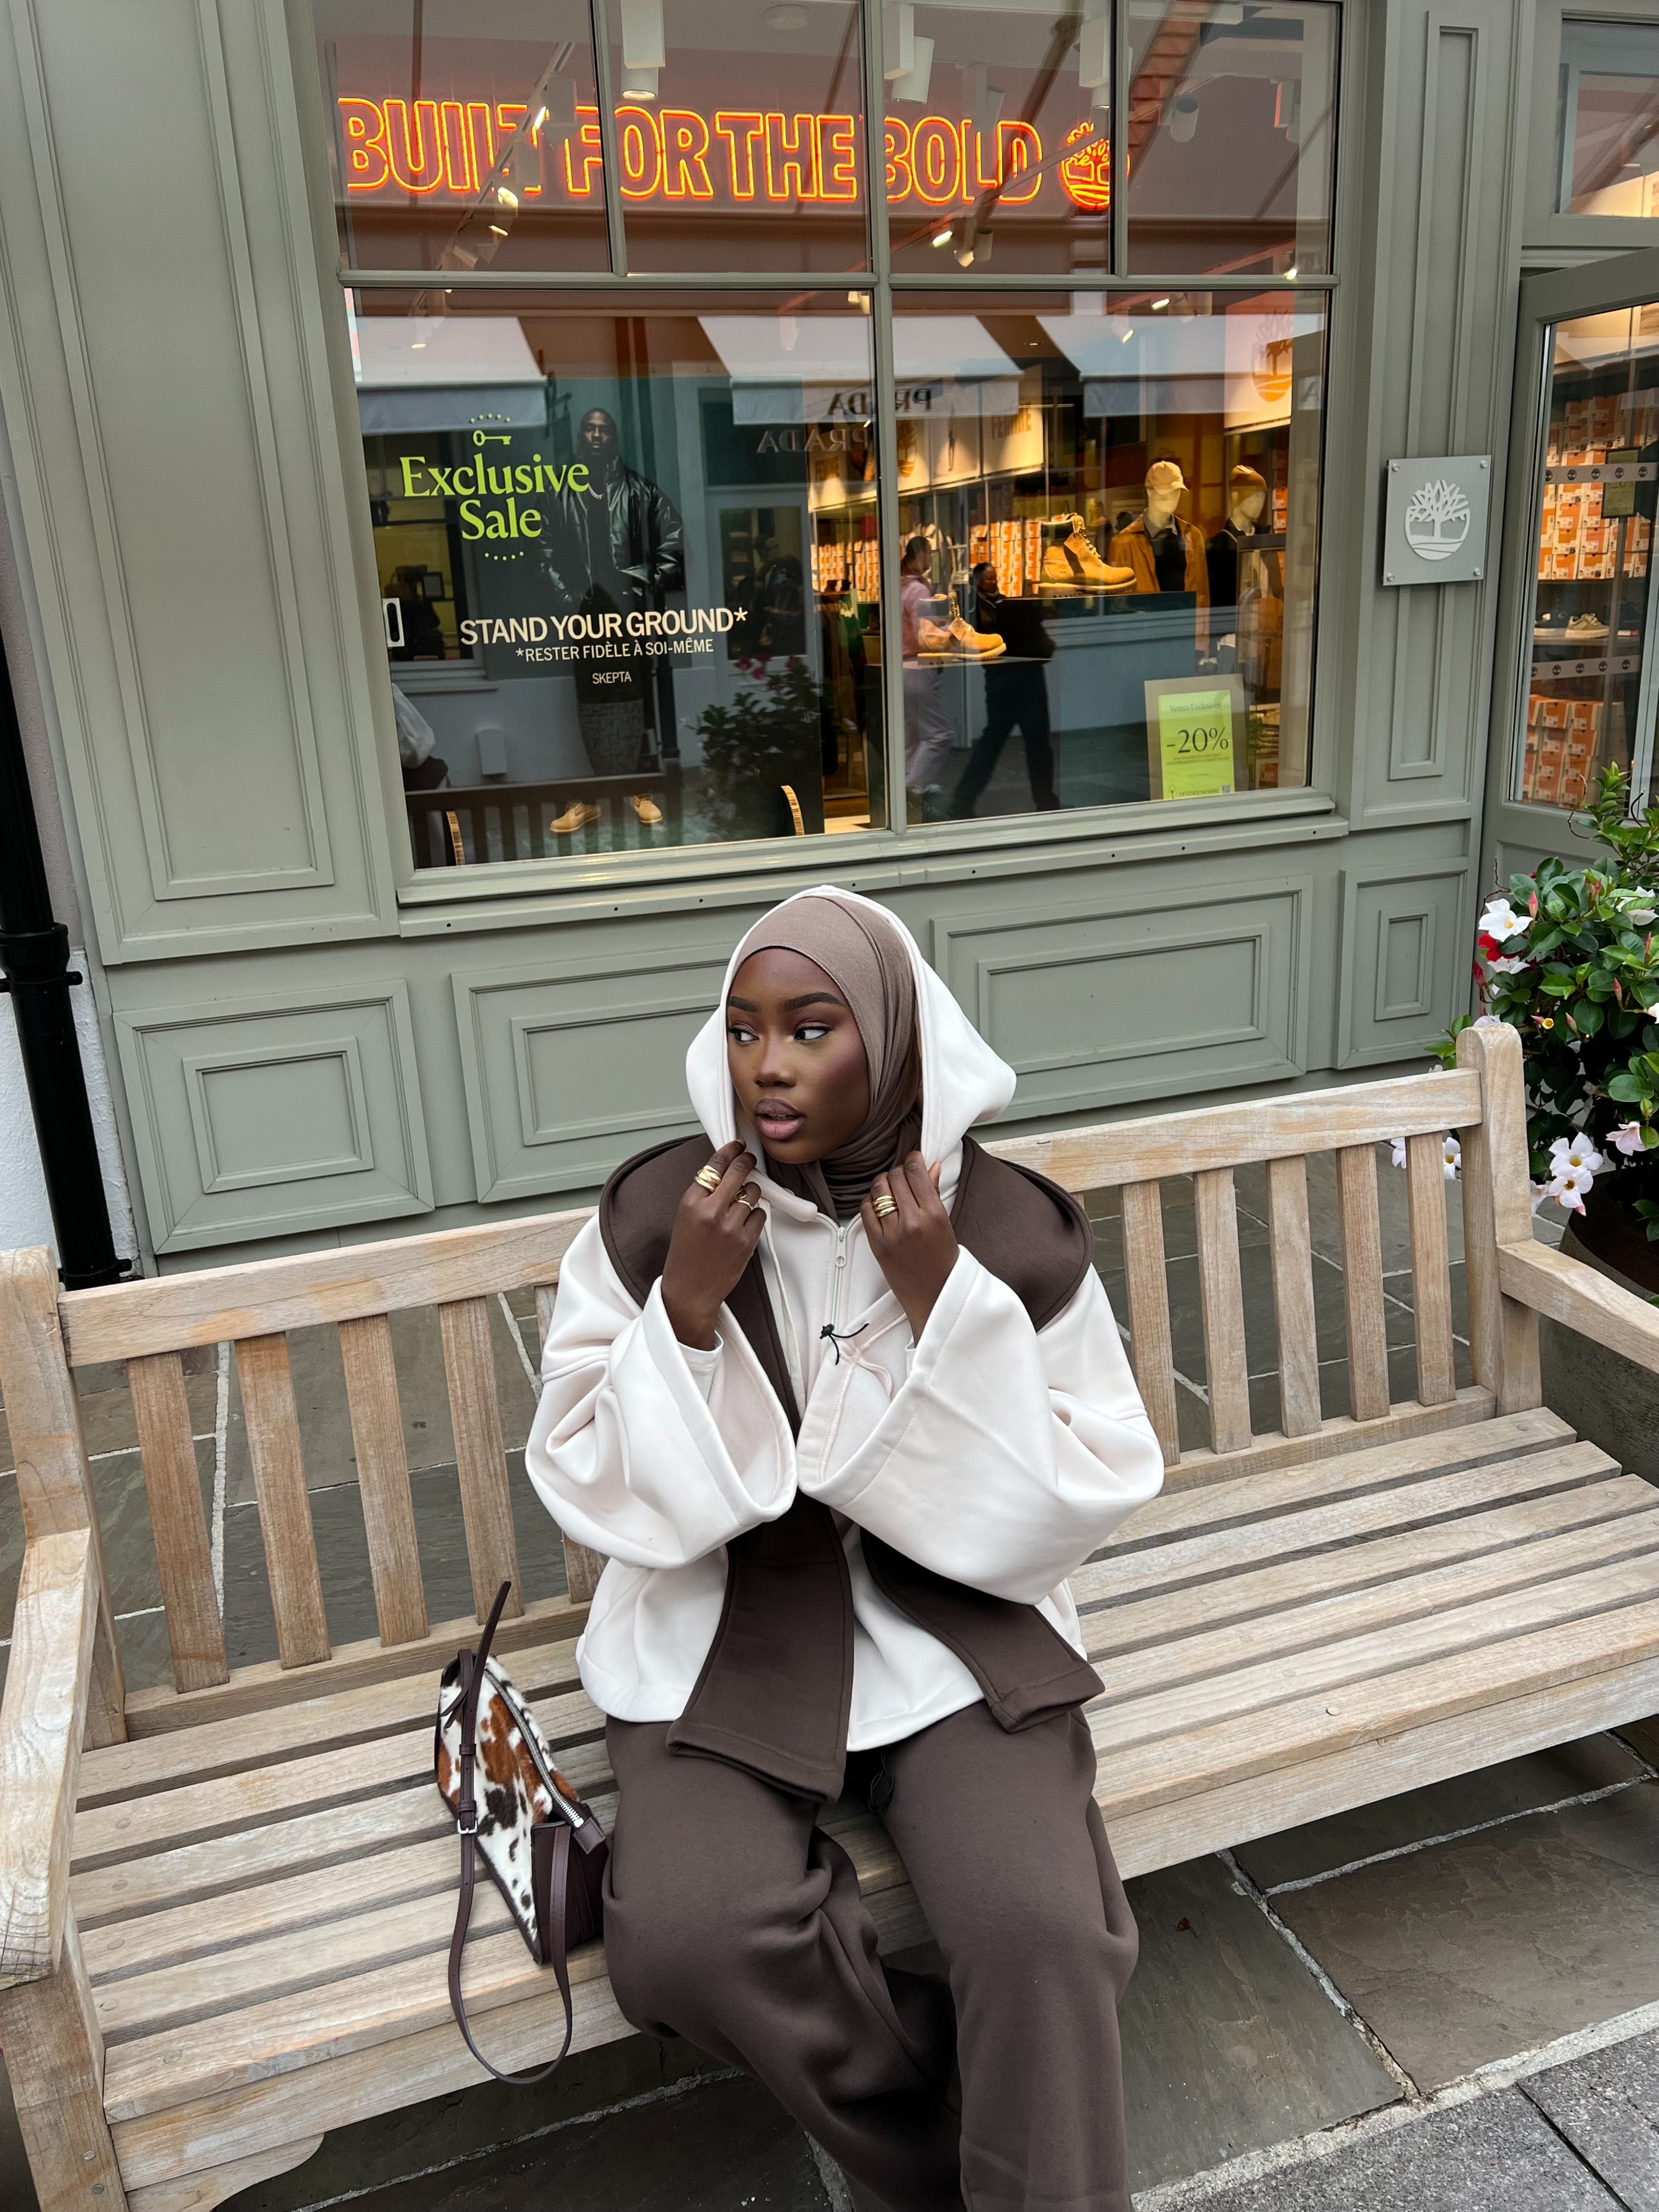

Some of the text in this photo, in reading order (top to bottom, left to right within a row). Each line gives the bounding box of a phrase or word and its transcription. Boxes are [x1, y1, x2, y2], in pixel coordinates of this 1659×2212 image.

[561, 105, 714, 198] FOR
[715, 111, 857, 200] THE
[884, 115, 1043, 203] BOLD
[399, 453, 590, 497] Exclusive
[459, 496, 542, 540] Sale
[460, 617, 548, 645] STAND
[550, 613, 623, 640] YOUR
[583, 641, 631, 659] FIDÈLE
[633, 640, 643, 657] À
[645, 636, 714, 656] SOI-MÊME
[592, 671, 632, 685] SKEPTA
[1166, 726, 1229, 754] -20%
